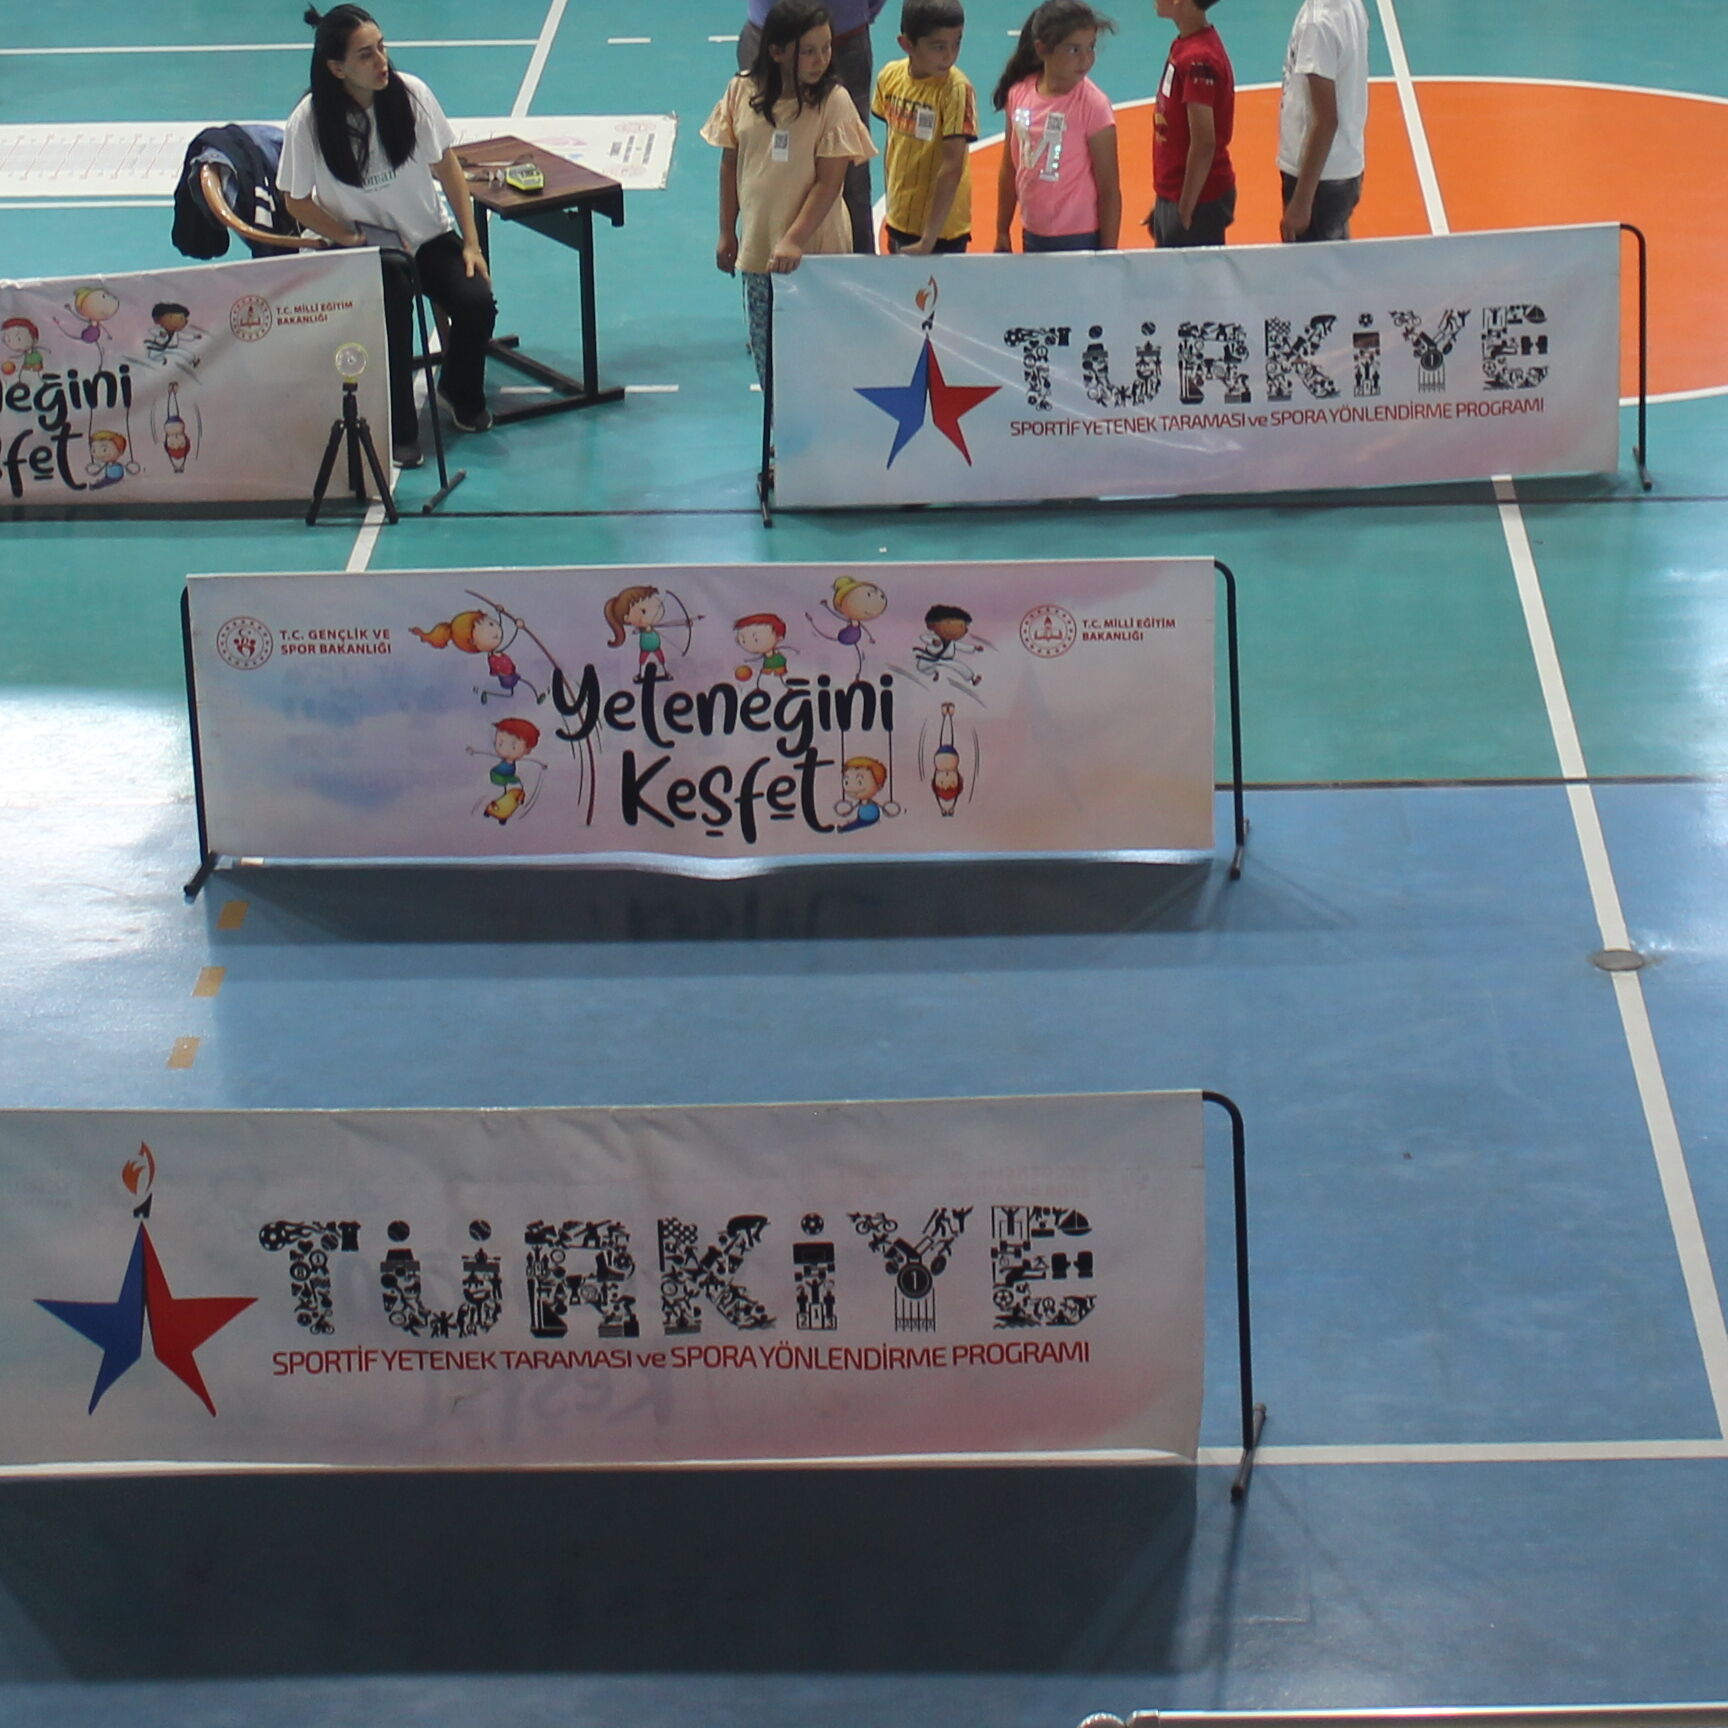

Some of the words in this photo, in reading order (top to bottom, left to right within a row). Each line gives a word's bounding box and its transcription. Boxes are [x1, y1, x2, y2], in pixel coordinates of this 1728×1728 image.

[1003, 303, 1549, 412] TÜRKİYE
[1010, 416, 1079, 437] SPORTİF
[1078, 416, 1157, 436] YETENEK
[1157, 412, 1245, 434] TARAMASI
[1248, 414, 1268, 428] ve
[1270, 409, 1327, 428] SPORA
[1326, 400, 1452, 425] YÖNLENDİRME
[1455, 396, 1545, 419] PROGRAMI
[280, 629, 304, 641] T.C.
[308, 627, 368, 643] GENÇLİK
[372, 628, 390, 640] VE
[1082, 619, 1102, 630] T.C.
[1136, 616, 1176, 629] EĞİTİM
[1082, 629, 1144, 641] BAKANLIĞI
[280, 644, 316, 655] SPOR
[320, 640, 392, 655] BAKANLIĞI
[622, 747, 835, 844] Keşfet
[258, 1202, 1097, 1339] TÜRKİYE
[272, 1346, 379, 1377] SPORTİF
[380, 1349, 498, 1374] YETENEK
[499, 1349, 632, 1371] TARAMASI
[636, 1354, 666, 1370] ve
[670, 1345, 758, 1370] SPORA
[757, 1339, 948, 1373] YÖNLENDİRME
[952, 1339, 1091, 1367] PROGRAMI
